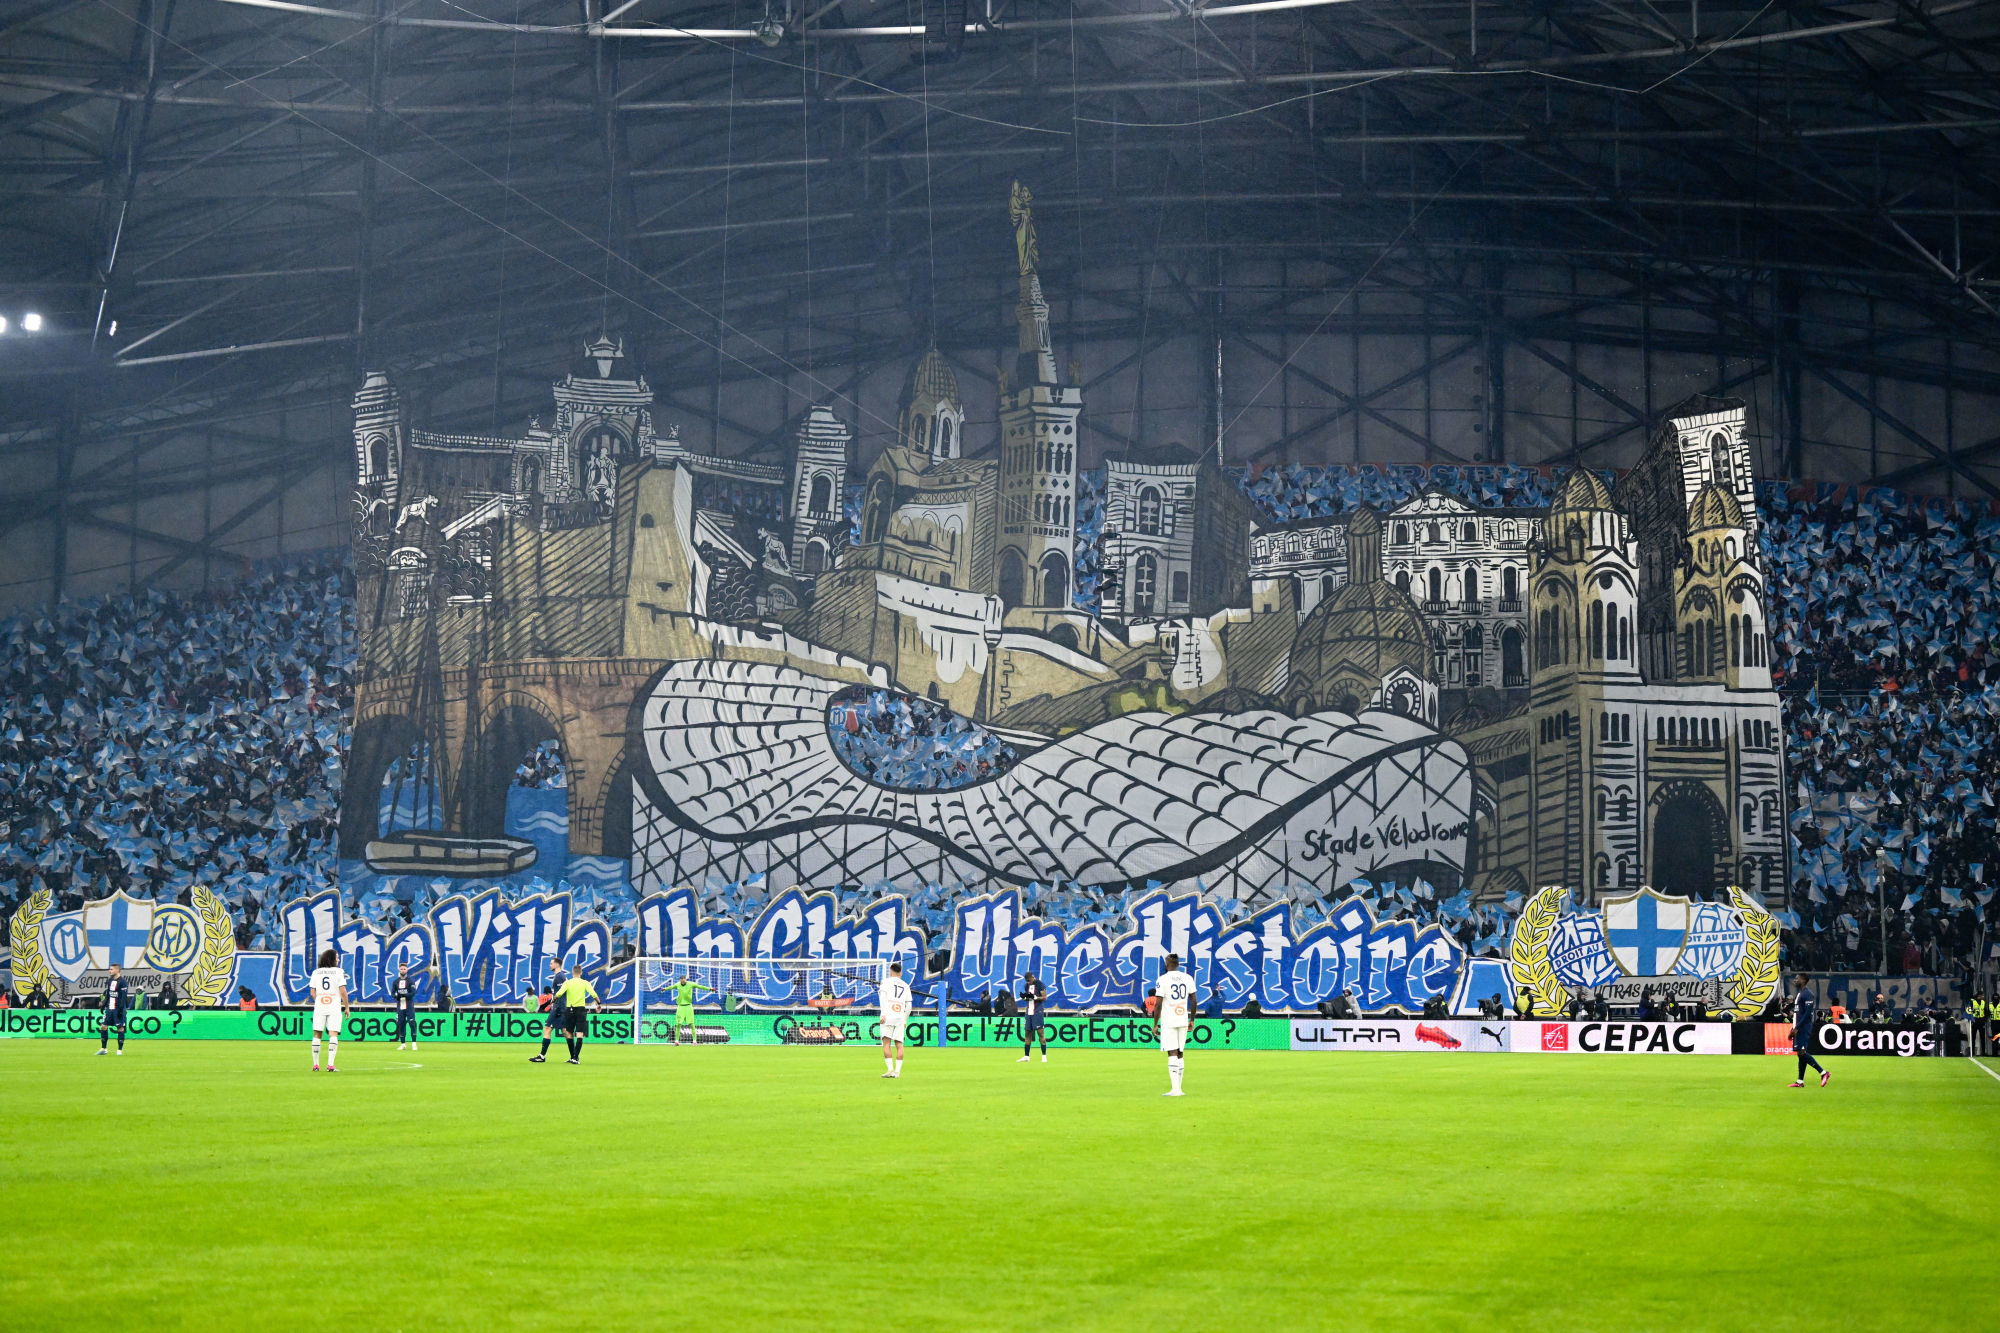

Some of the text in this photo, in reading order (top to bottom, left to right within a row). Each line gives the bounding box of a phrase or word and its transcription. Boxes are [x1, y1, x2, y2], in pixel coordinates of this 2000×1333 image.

[1301, 811, 1468, 861] Stade Vélodrome
[283, 889, 432, 1005] Une
[431, 888, 618, 1006] Ville
[638, 888, 746, 1006] Un
[750, 887, 928, 1008] Club
[955, 888, 1109, 1010] Une
[1705, 934, 1718, 942] AU
[1721, 932, 1740, 941] BUT
[1555, 947, 1583, 968] DROIT
[1586, 943, 1599, 954] AU
[322, 976, 330, 990] 6
[894, 984, 905, 999] 17
[1171, 983, 1187, 1000] 30
[168, 1011, 182, 1034] ?
[258, 1011, 303, 1036] Qui
[348, 1018, 446, 1042] gager
[1220, 1019, 1236, 1044] ?
[1296, 1028, 1400, 1042] ULTRA
[1578, 1023, 1697, 1053] CEPAC
[1818, 1023, 1936, 1057] Orange
